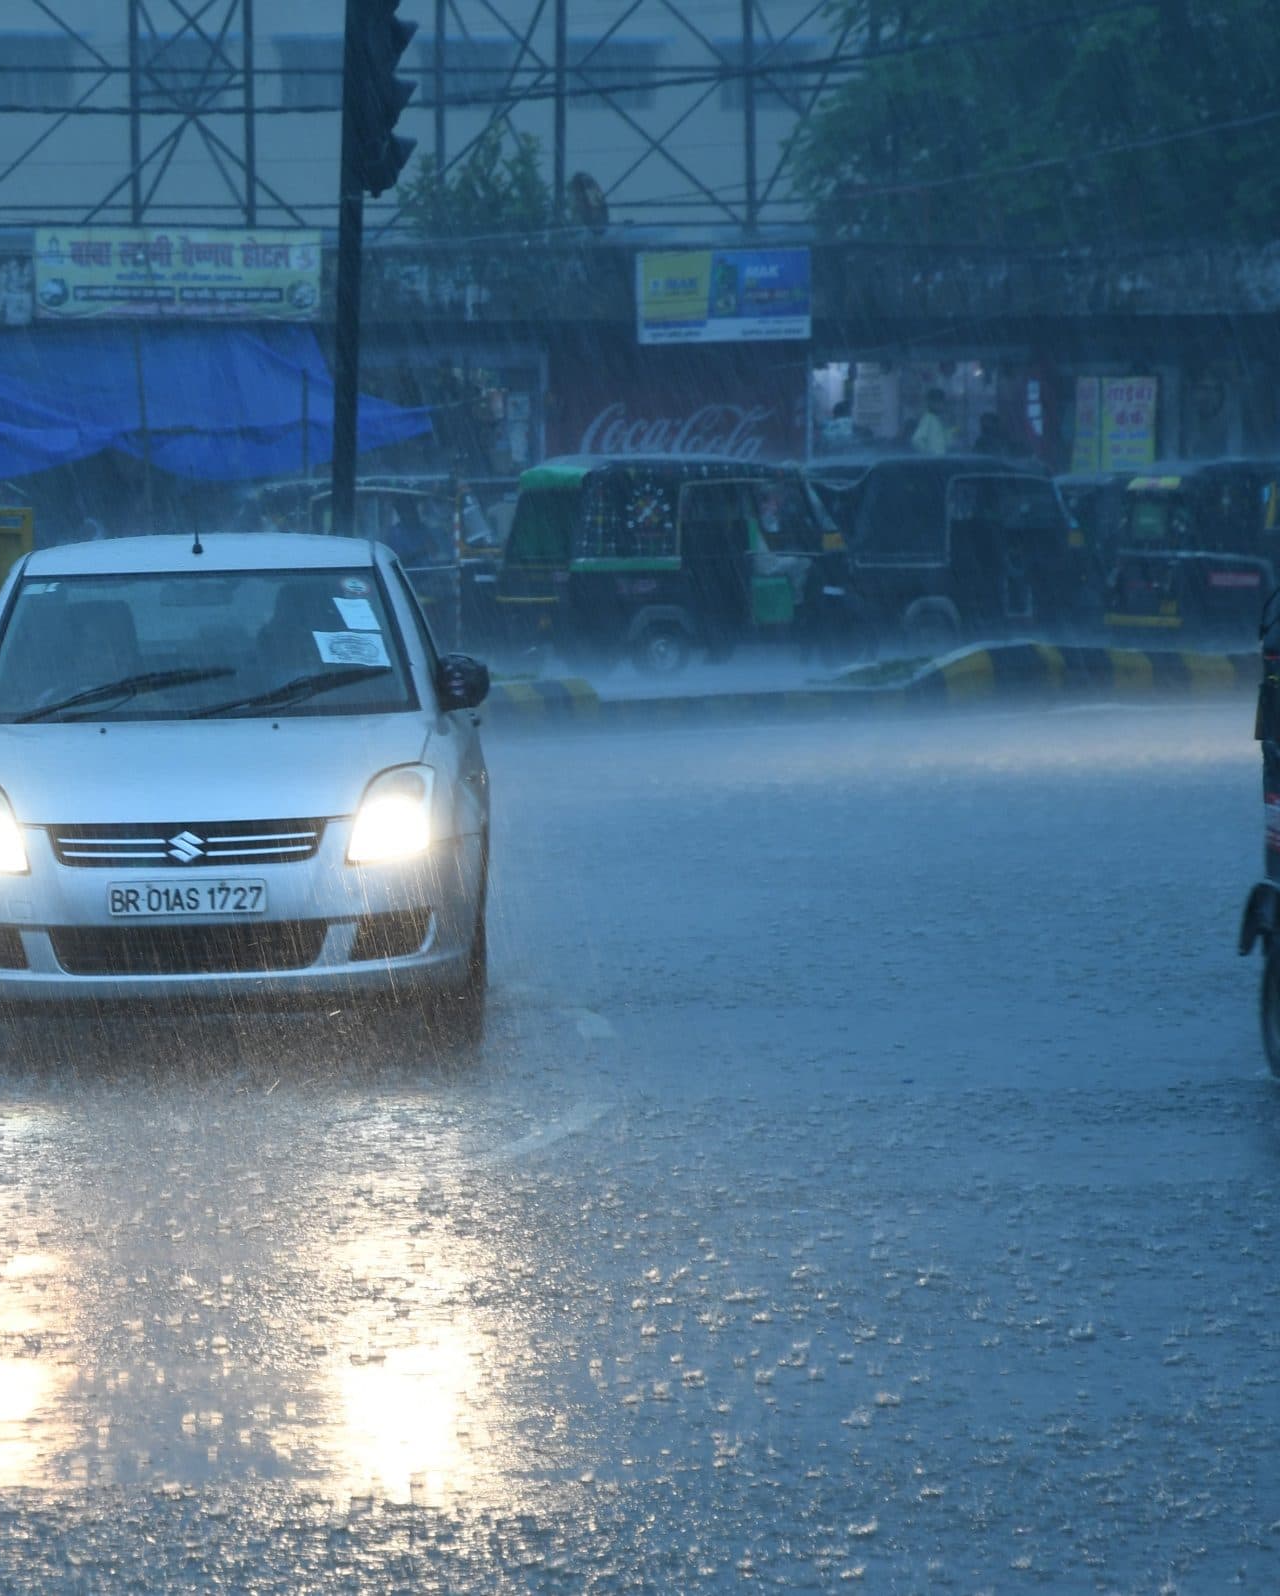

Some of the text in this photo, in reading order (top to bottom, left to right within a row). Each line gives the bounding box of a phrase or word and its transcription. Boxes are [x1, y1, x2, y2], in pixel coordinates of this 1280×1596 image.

[745, 264, 780, 278] MAK
[580, 401, 777, 459] Coca-Cola
[207, 886, 263, 910] 1727
